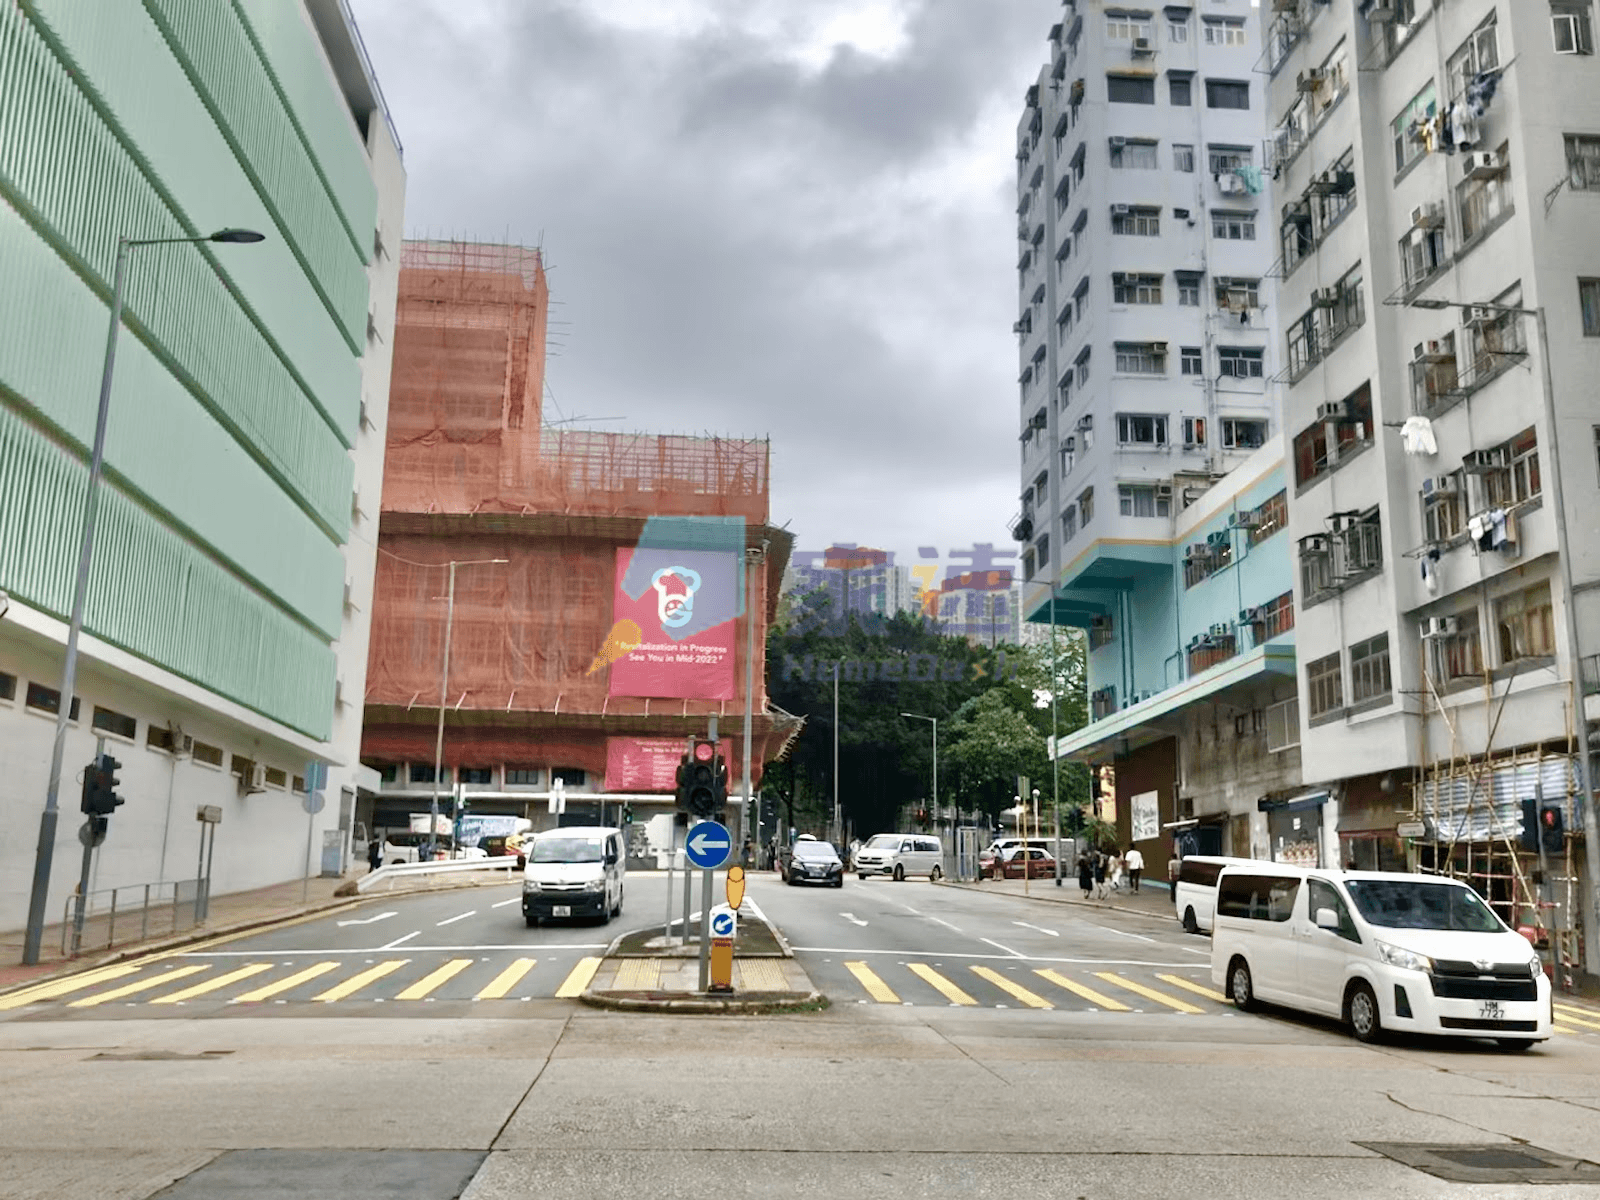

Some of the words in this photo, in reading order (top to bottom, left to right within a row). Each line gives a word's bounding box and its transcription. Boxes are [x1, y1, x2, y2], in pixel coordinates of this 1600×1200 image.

[679, 643, 690, 651] in
[690, 644, 727, 654] Progress
[629, 653, 645, 661] See
[648, 654, 664, 662] You
[665, 654, 674, 662] in
[1479, 1009, 1504, 1018] 7727
